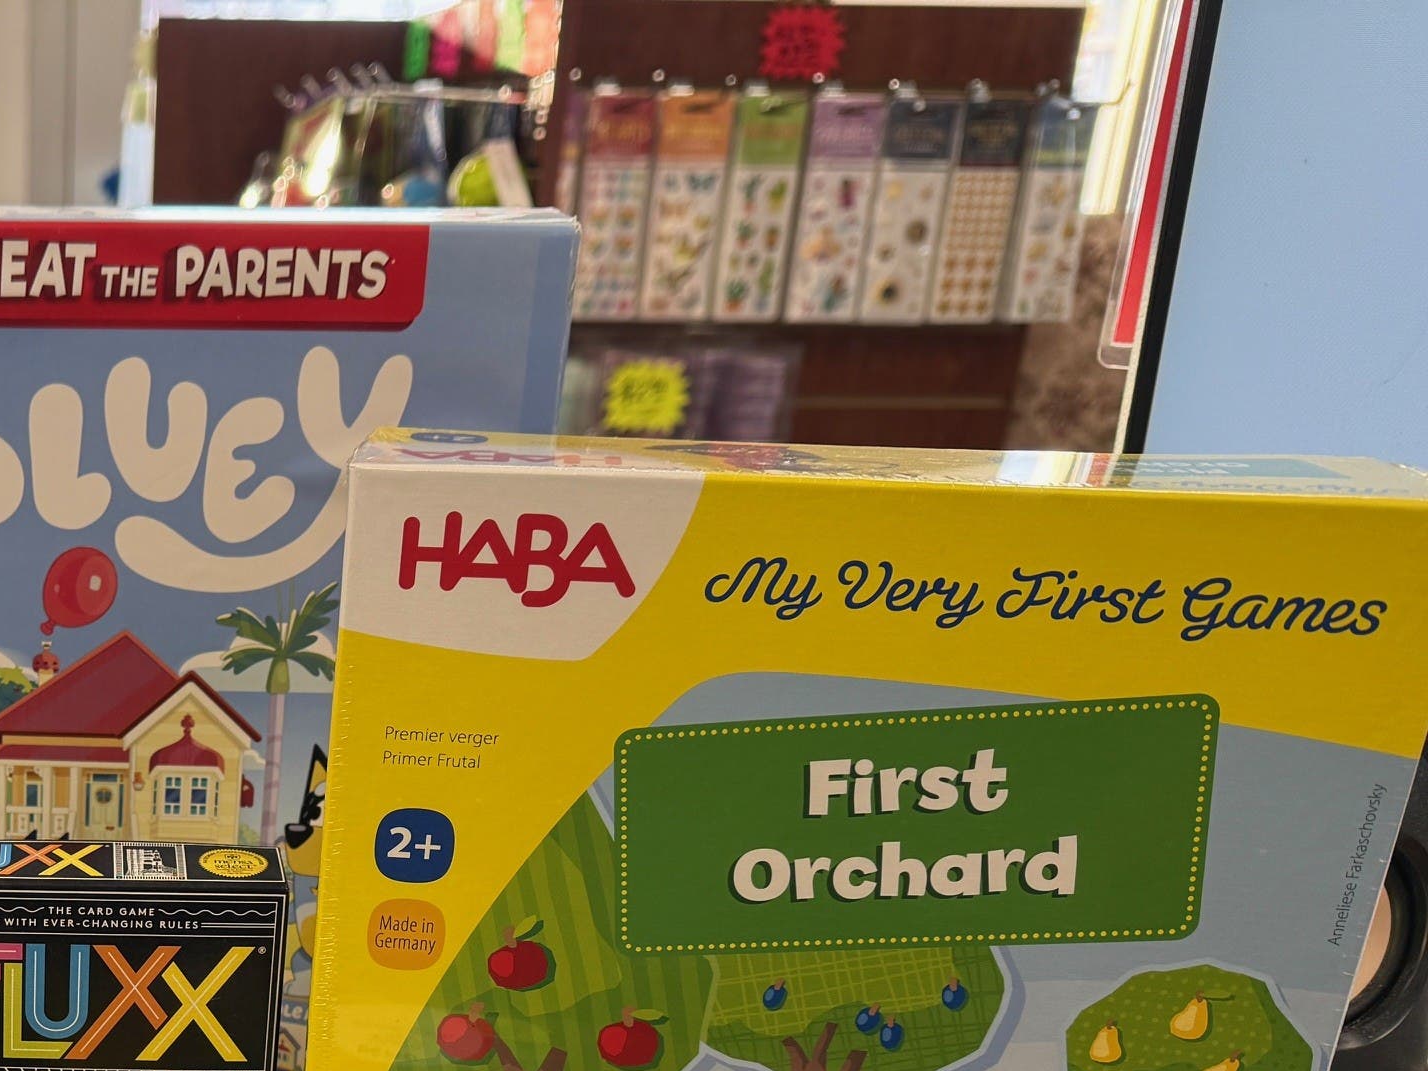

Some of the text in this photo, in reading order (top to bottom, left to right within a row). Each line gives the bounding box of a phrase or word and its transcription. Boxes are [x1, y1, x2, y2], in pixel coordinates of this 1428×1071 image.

[101, 266, 159, 298] THE
[175, 245, 389, 300] PARENTS
[398, 511, 636, 608] HABA
[704, 557, 1388, 643] My Very First Games
[384, 726, 499, 747] Premier verger
[382, 750, 481, 769] Primer Frutal
[805, 749, 1009, 817] First
[386, 827, 441, 860] 2+
[731, 835, 1079, 902] Orchard
[1327, 783, 1388, 946] Anneliese Farkaschovsky
[4, 917, 199, 931] WITH EVER-CHANGING RULES
[48, 906, 155, 917] THE CARD GAME
[379, 914, 435, 934] Made in
[375, 932, 436, 955] Germany
